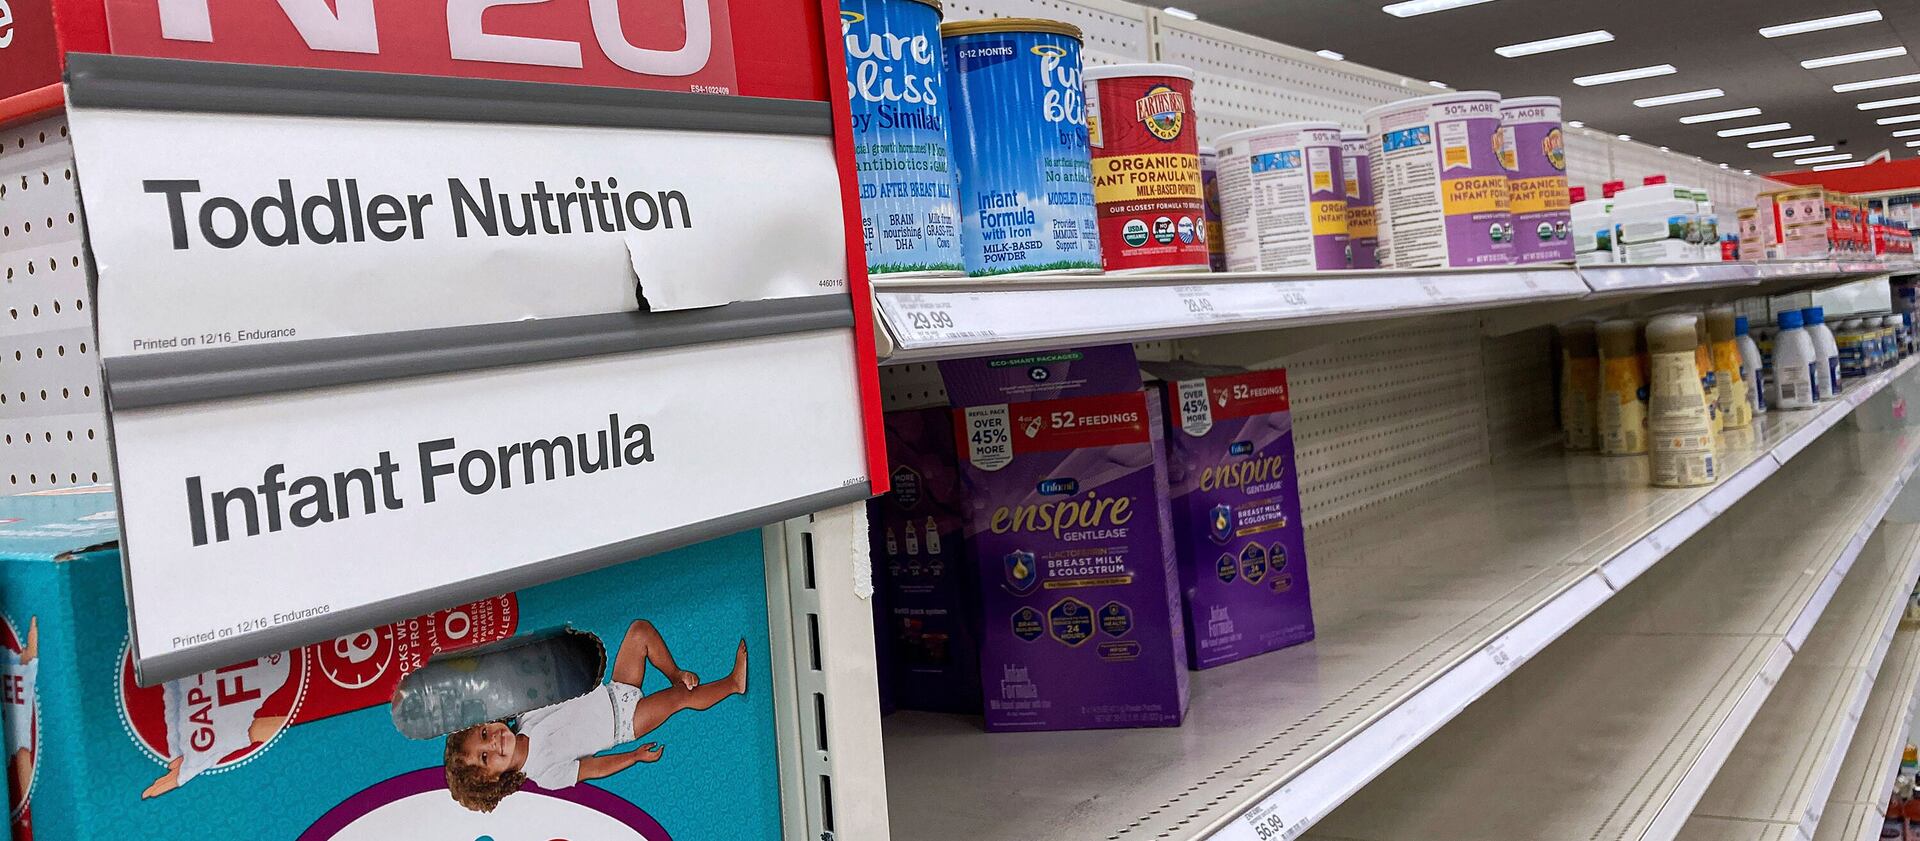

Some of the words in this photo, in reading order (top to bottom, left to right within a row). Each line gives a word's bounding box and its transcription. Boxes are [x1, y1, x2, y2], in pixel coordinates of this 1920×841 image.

[841, 19, 931, 65] ure
[959, 49, 977, 59] 0-12
[978, 46, 1013, 58] MONTHS
[846, 60, 937, 105] liss
[1444, 106, 1467, 115] 50%
[1470, 104, 1494, 113] MORE
[1518, 109, 1545, 118] MORE
[1108, 156, 1178, 173] ORGANIC
[1046, 171, 1060, 182] No
[1130, 171, 1185, 184] FORMULA
[881, 182, 908, 198] AFTER
[1136, 184, 1177, 197] MILK-BASED
[1454, 180, 1502, 191] ORGANIC
[978, 189, 1018, 210] Infant
[1450, 190, 1488, 202] INFANT
[143, 178, 433, 250] Toddler
[448, 176, 692, 238] Nutrition
[1109, 205, 1125, 214] OUR
[1126, 203, 1155, 212] CLOSEST
[889, 213, 914, 225] BRAIN
[980, 207, 1035, 229] Formula
[883, 228, 921, 239] nourishing
[982, 228, 1006, 241] with
[1010, 228, 1032, 239] Iron
[896, 239, 914, 250] DHA
[983, 241, 1043, 254] MILK-BASED
[984, 252, 1027, 264] POWDER
[907, 311, 953, 329] 29.99
[133, 336, 177, 351] Printed
[181, 336, 196, 347] on
[200, 327, 296, 345] 12/16_Endurance
[1183, 390, 1203, 399] OVER
[1233, 384, 1249, 400] 52
[1249, 385, 1284, 397] FEEDINGS
[1183, 399, 1208, 413] 45%
[974, 418, 1002, 428] OVER
[1051, 411, 1076, 428] 52
[1078, 412, 1138, 426] FEEDINGS
[1186, 414, 1207, 423] MORE
[972, 428, 1007, 444] 45%
[976, 445, 1005, 455] MORE
[1199, 451, 1284, 494] enspire
[185, 463, 404, 547] Infant
[418, 412, 655, 504] Formula
[990, 491, 1134, 539] enspire
[1237, 507, 1264, 519] BREAST
[1063, 529, 1127, 542] GENTLEASE
[1047, 558, 1092, 568] BREAST
[1095, 556, 1123, 565] MILK
[1057, 565, 1125, 577] COLOSTRUM
[409, 618, 420, 648] FRO
[1066, 624, 1080, 634] 24
[172, 629, 216, 649] Printed
[218, 627, 234, 639] on
[412, 653, 422, 672] AY
[1255, 814, 1284, 841] 56.99
